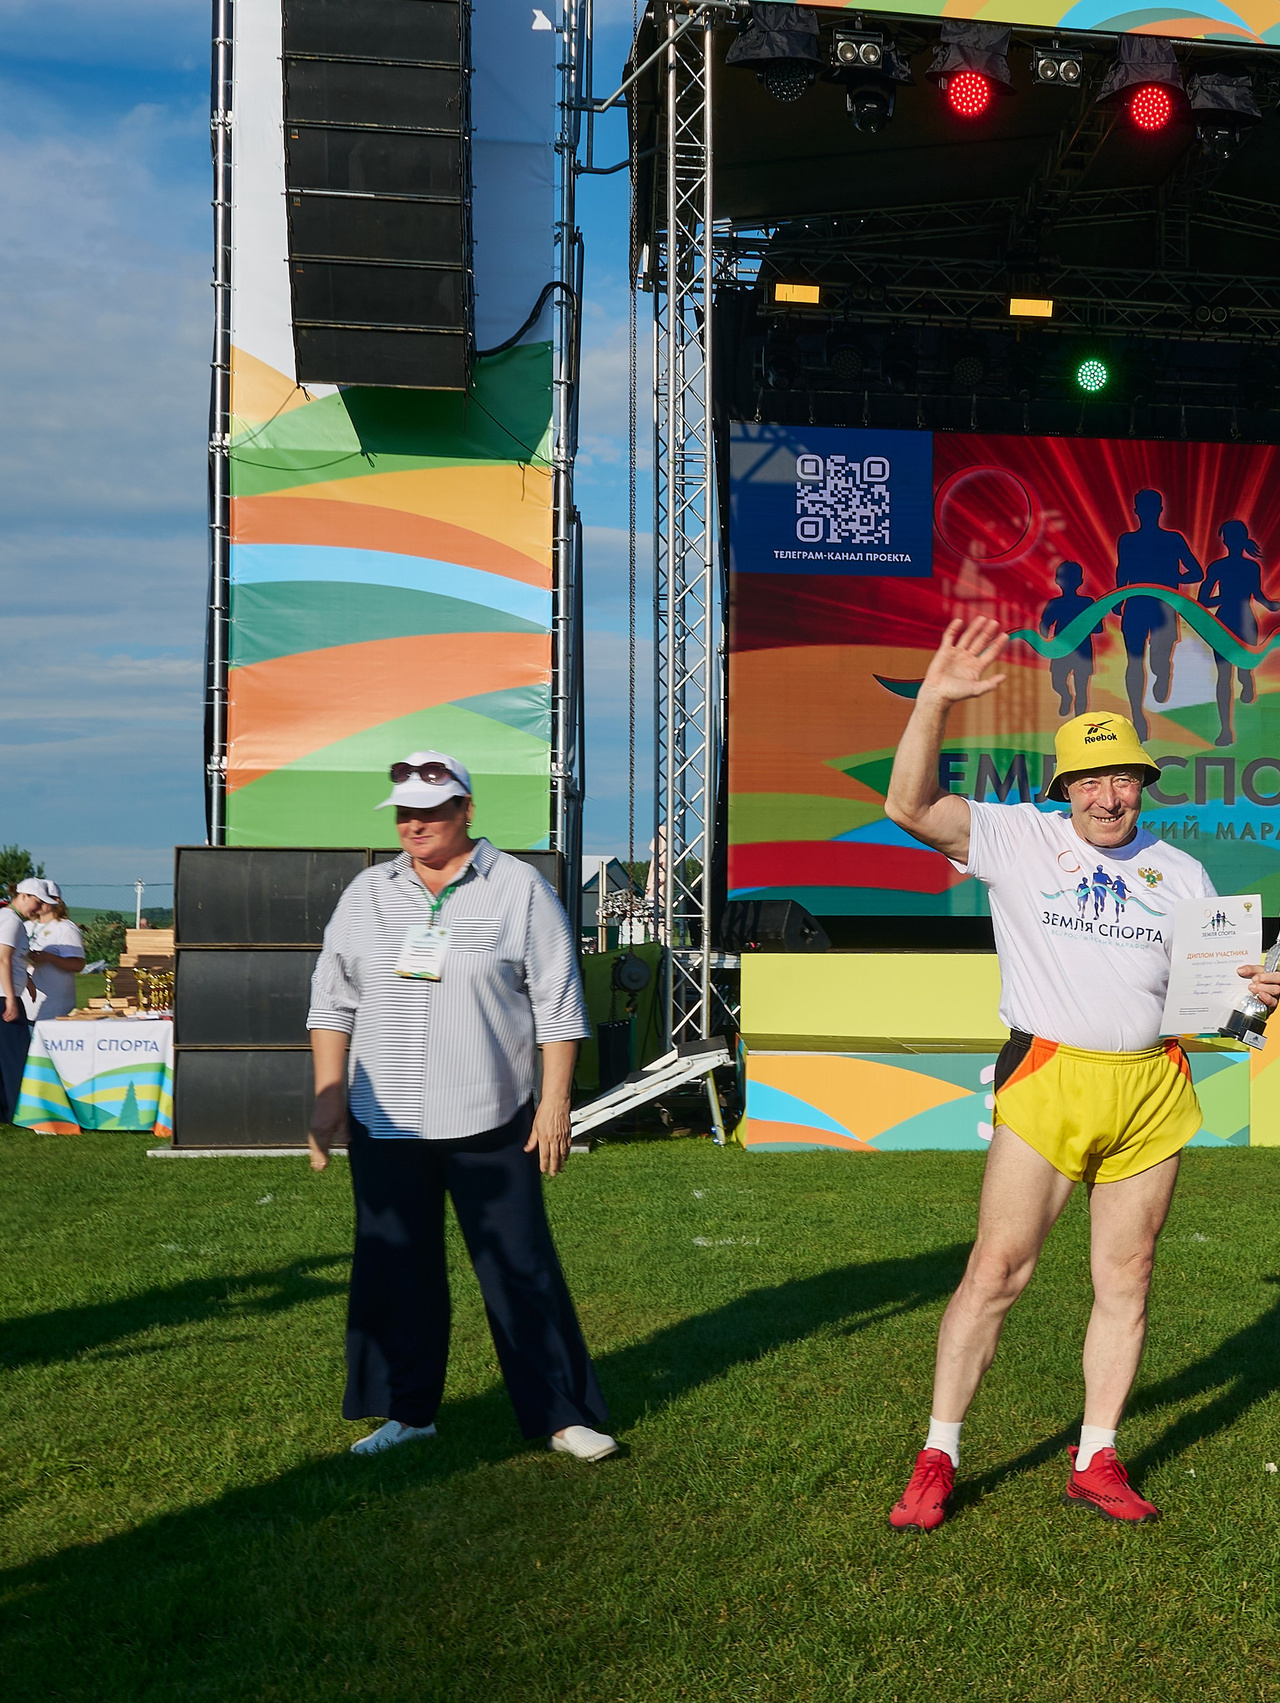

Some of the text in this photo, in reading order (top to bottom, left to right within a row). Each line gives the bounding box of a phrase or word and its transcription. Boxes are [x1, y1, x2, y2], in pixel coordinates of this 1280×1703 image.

[774, 550, 912, 562] ТЕЛЕГРАМ-КАНАЛ ПРОЕКТА
[1084, 732, 1118, 745] Reebok
[1042, 911, 1163, 944] ЗЕМЛЯ СПОРТА
[1187, 950, 1248, 960] ДИПЛОМ УЧАСТНИКА
[43, 1039, 160, 1052] ЕМЛЯ СПОРТА
